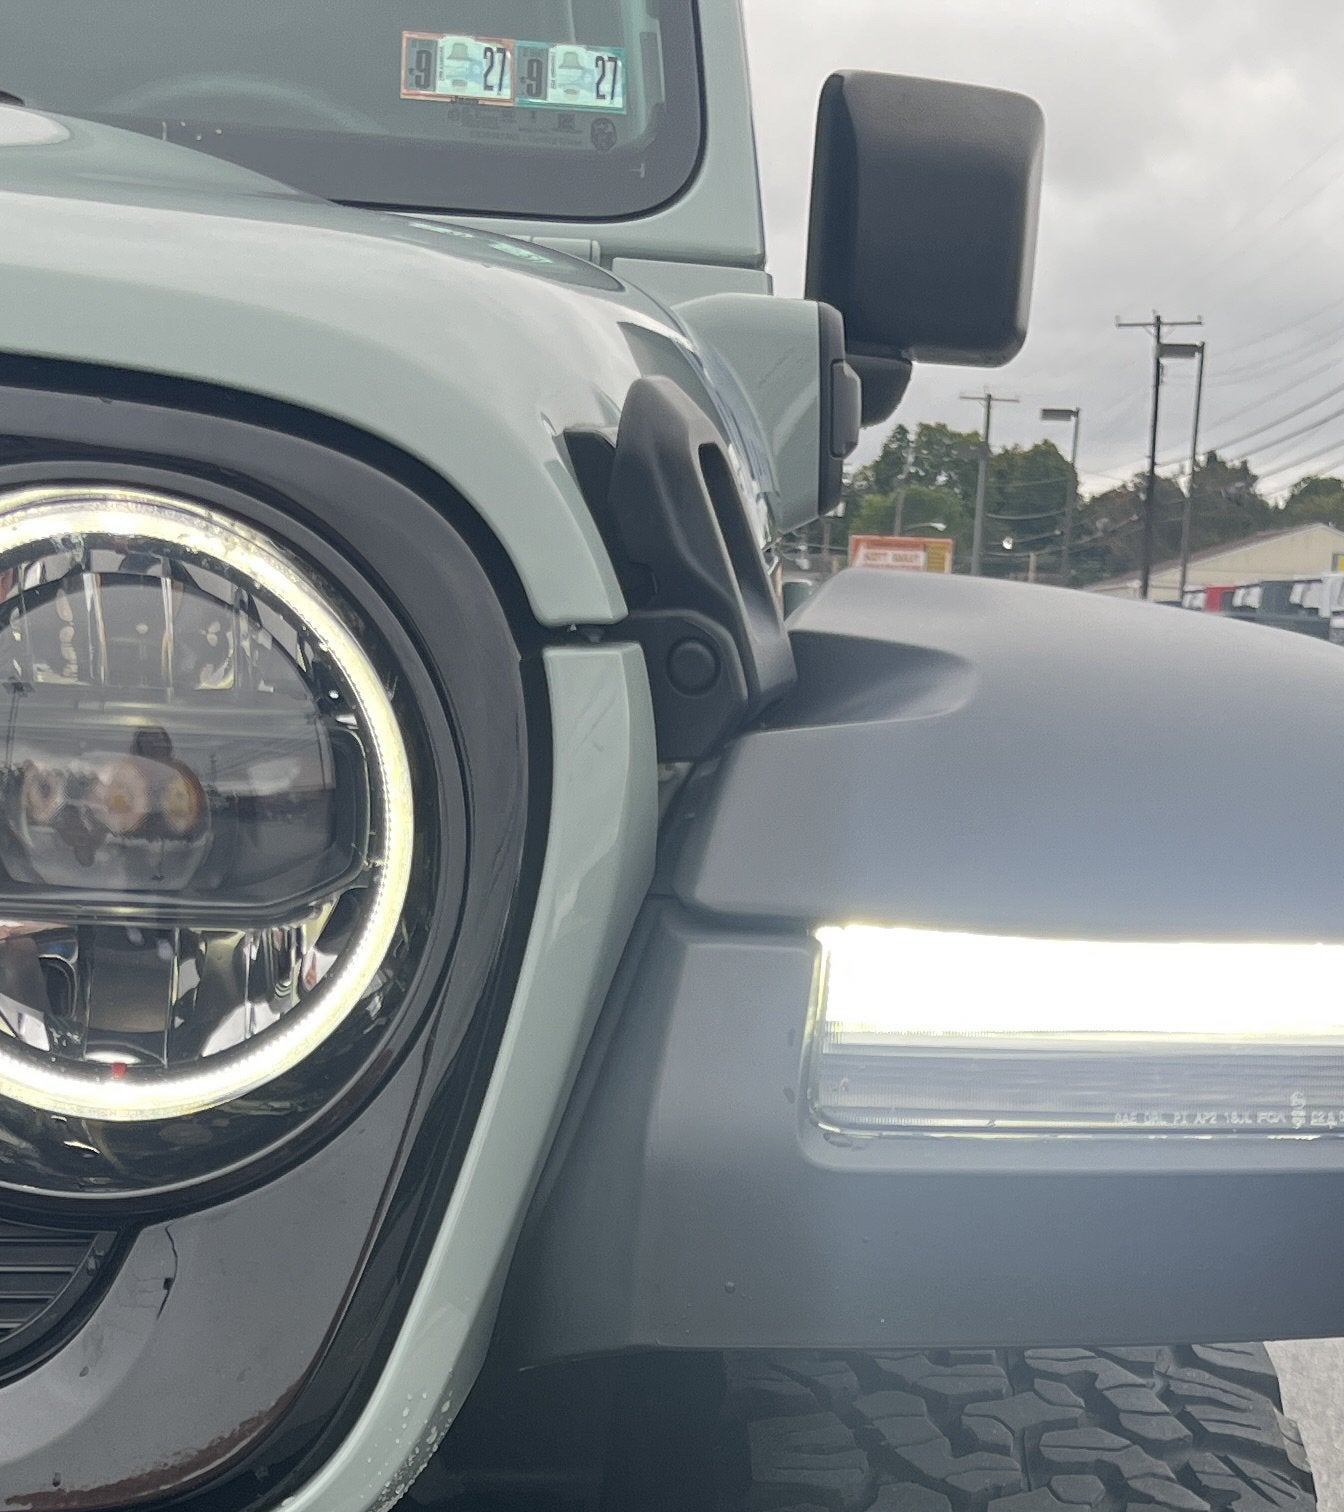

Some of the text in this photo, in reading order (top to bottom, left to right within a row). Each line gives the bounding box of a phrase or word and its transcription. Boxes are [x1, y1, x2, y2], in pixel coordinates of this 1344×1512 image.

[415, 50, 432, 89] 9
[483, 47, 506, 92] 27
[526, 58, 542, 97] 9
[595, 56, 618, 102] 27
